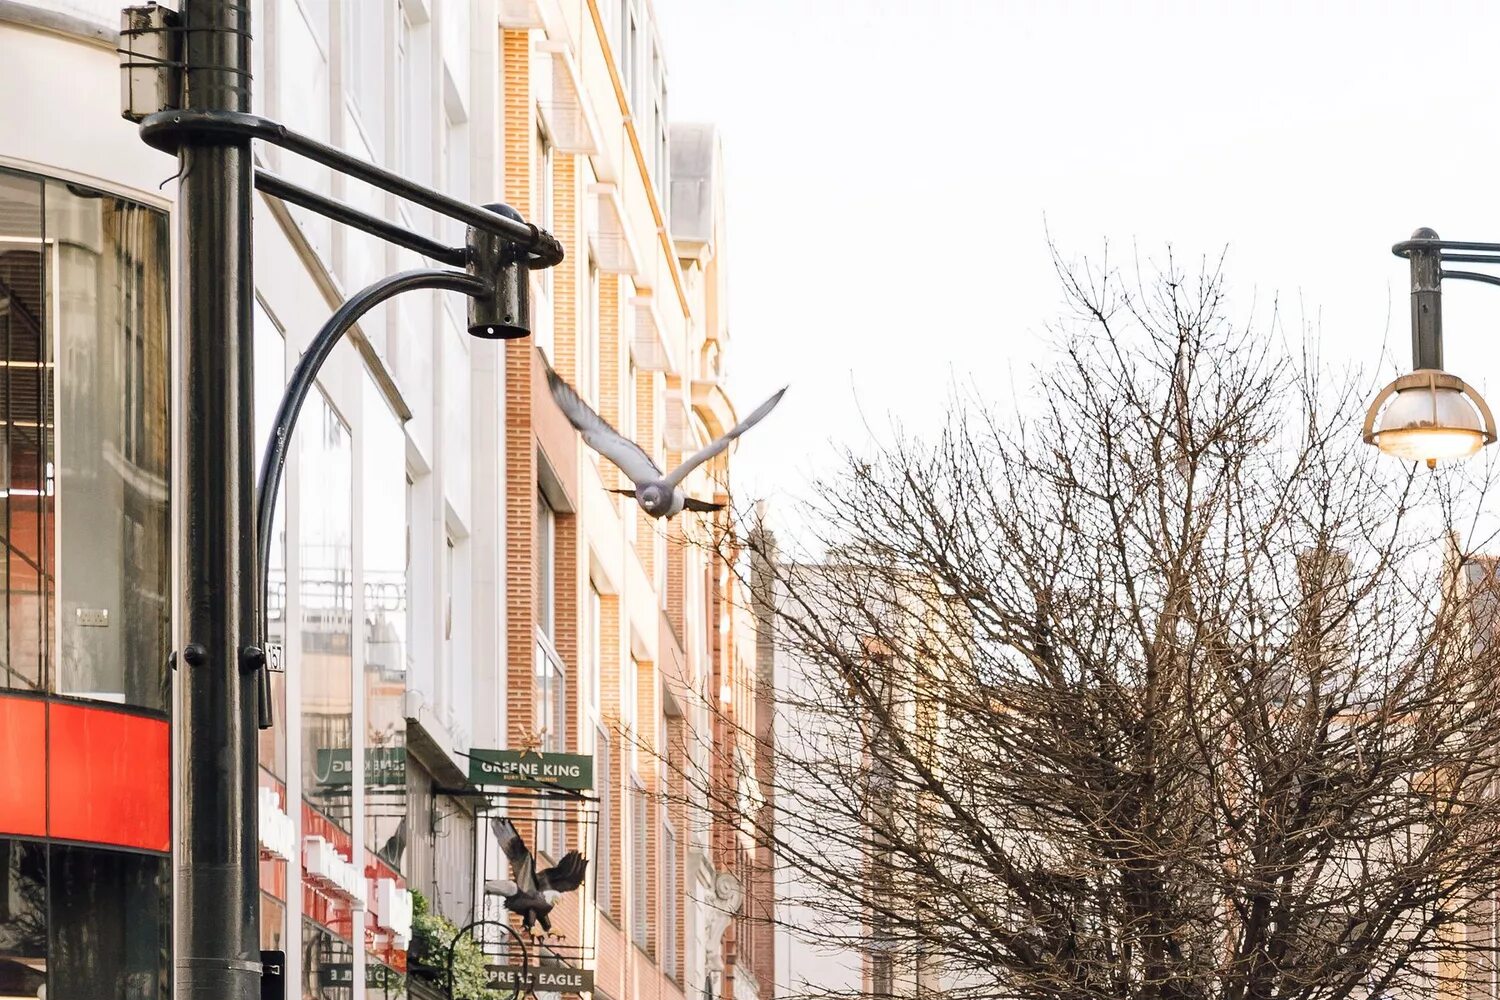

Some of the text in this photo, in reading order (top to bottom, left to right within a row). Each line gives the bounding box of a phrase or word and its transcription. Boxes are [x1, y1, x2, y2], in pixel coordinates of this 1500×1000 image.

[268, 646, 282, 669] 157
[543, 764, 580, 777] KING
[539, 973, 582, 986] EAGLE
